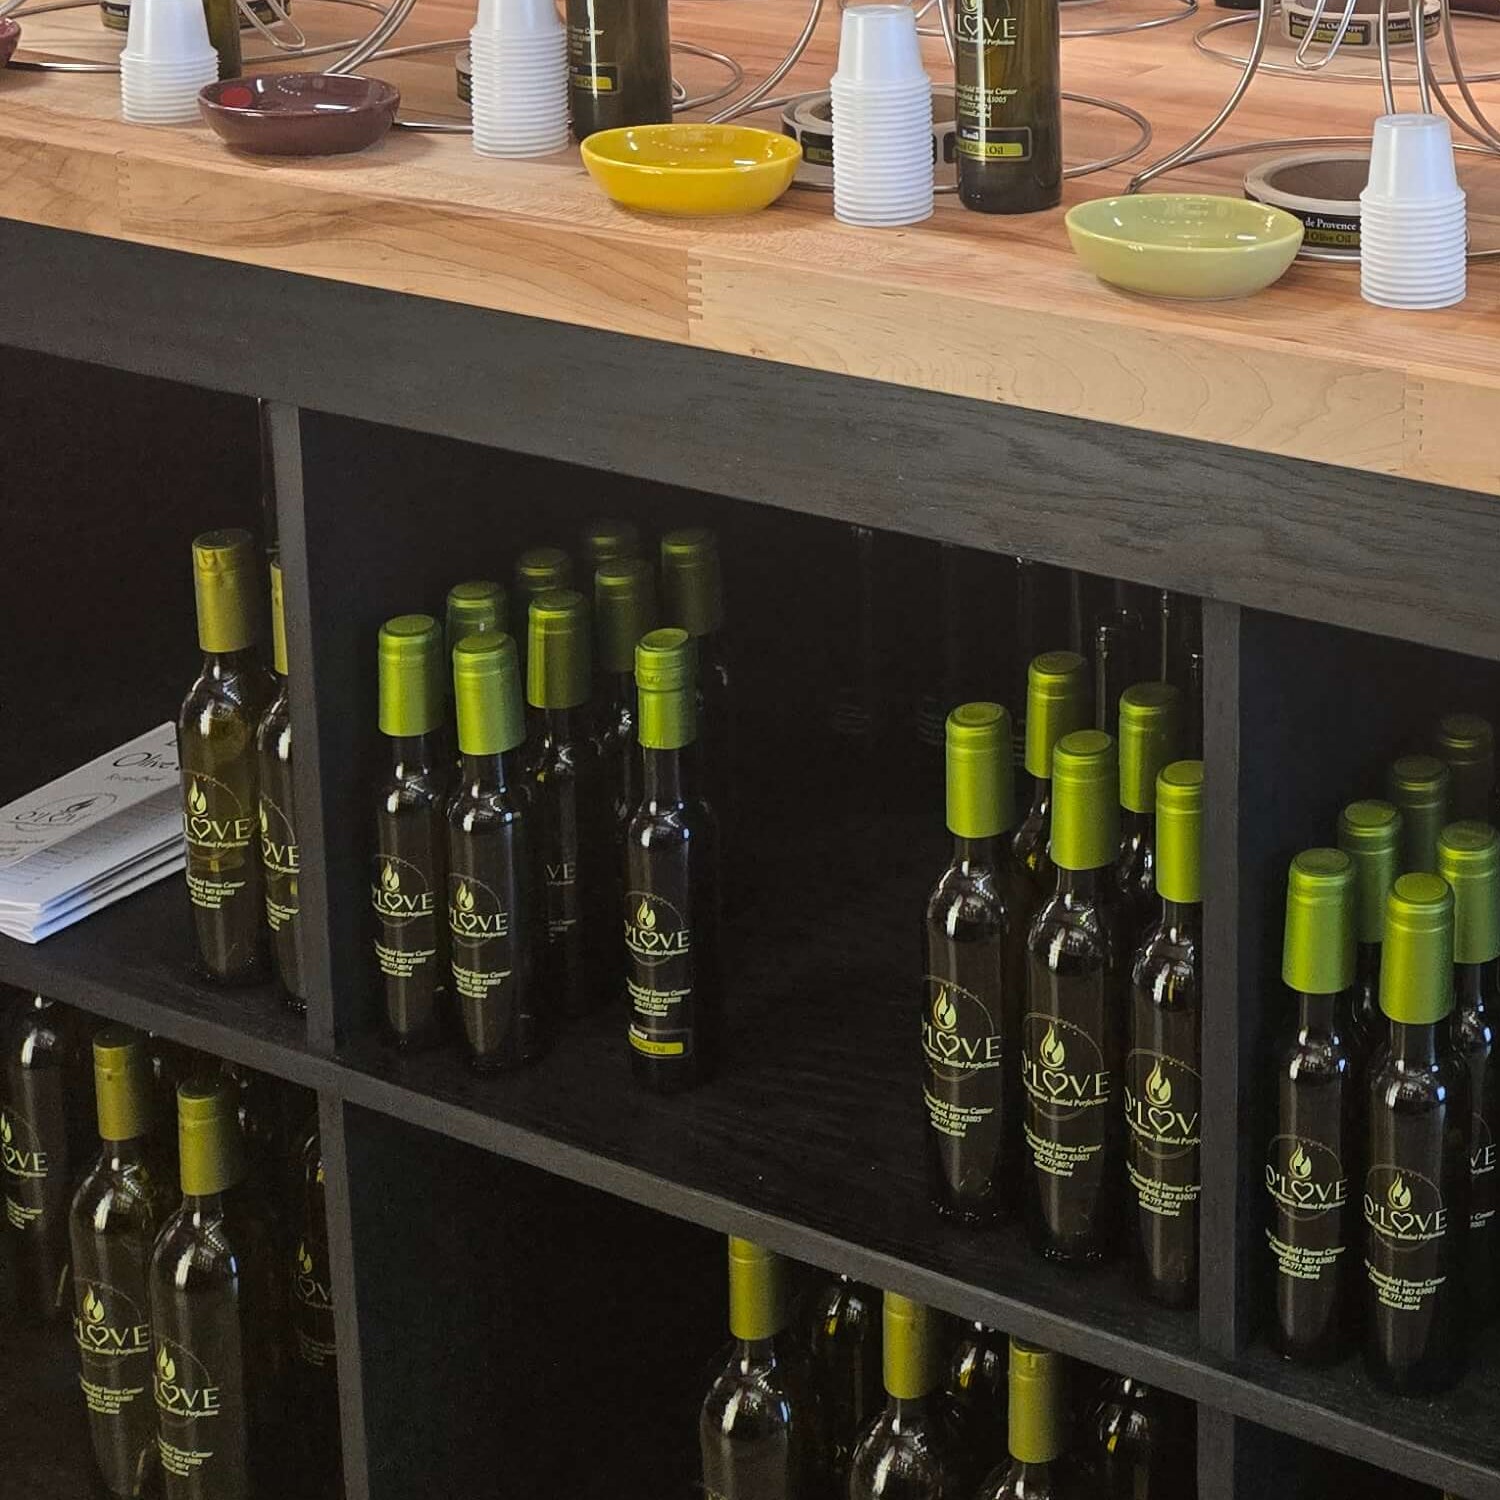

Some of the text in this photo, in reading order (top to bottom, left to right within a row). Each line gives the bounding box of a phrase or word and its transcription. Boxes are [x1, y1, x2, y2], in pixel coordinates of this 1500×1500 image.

[989, 145, 1004, 154] Oil
[1305, 217, 1357, 230] de Provence
[1125, 1086, 1198, 1134] O'LOV
